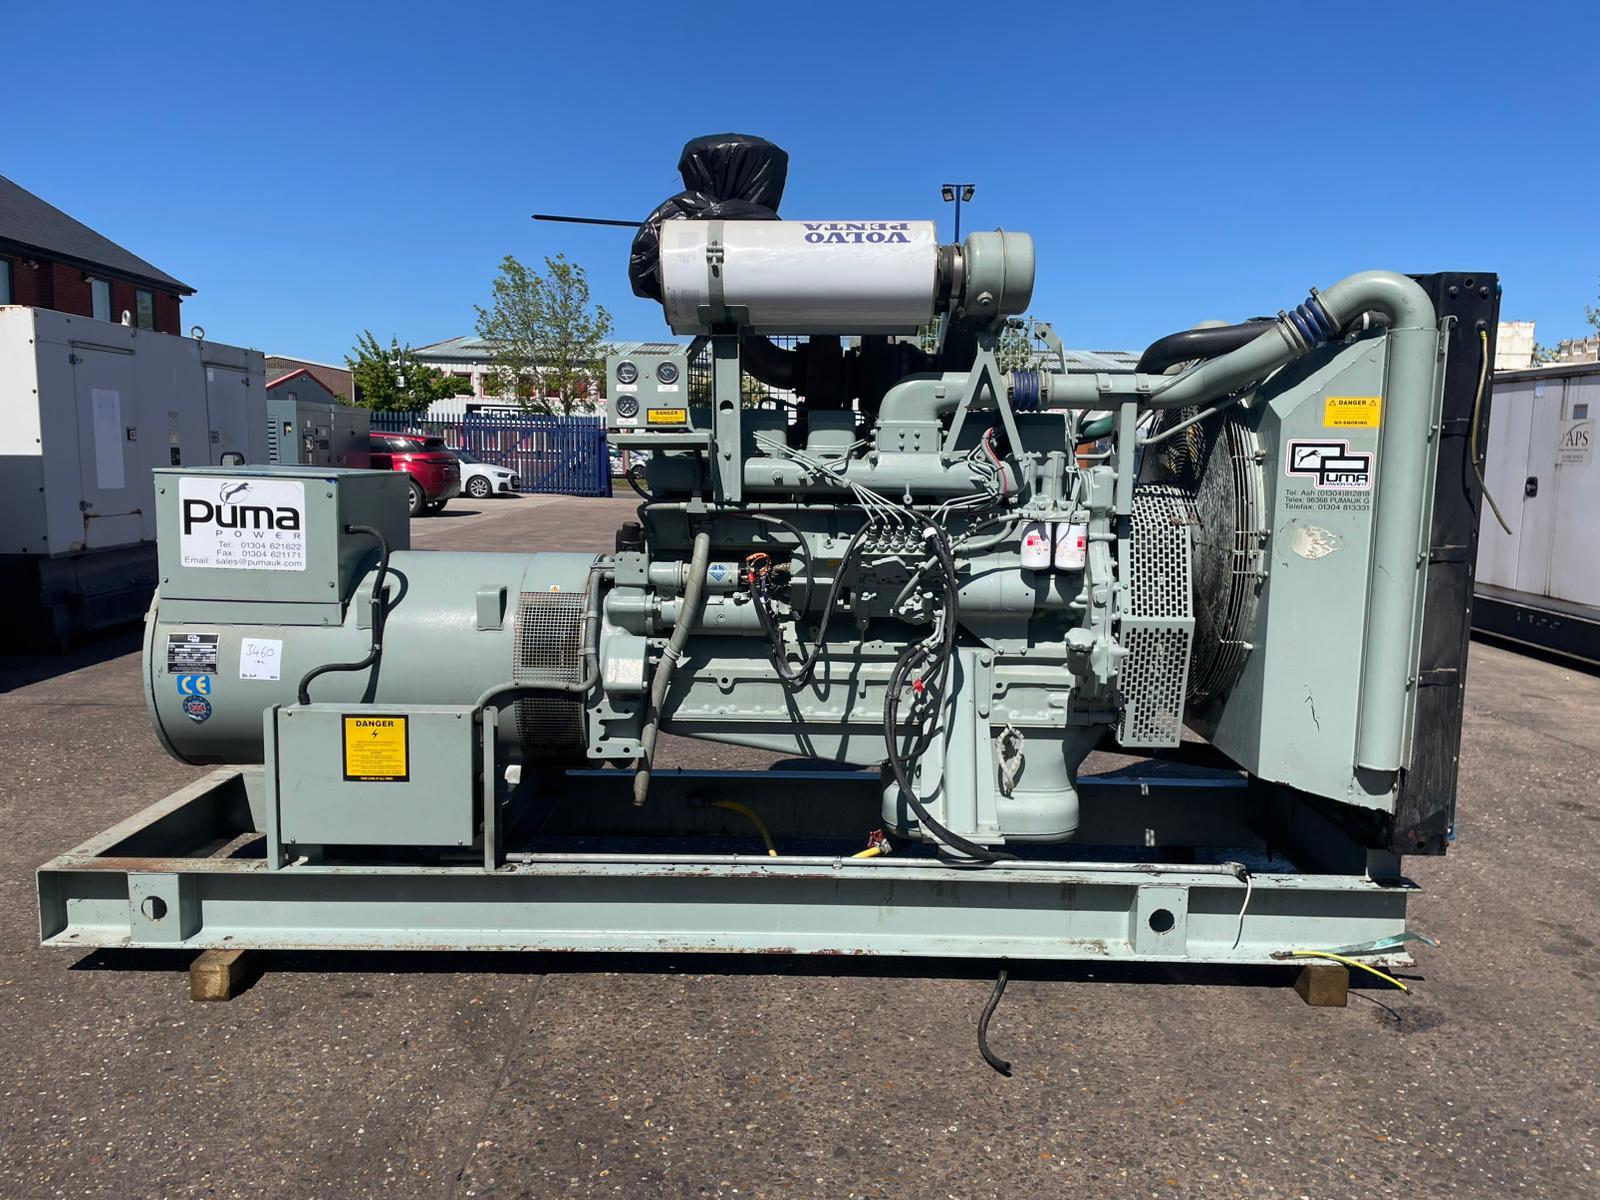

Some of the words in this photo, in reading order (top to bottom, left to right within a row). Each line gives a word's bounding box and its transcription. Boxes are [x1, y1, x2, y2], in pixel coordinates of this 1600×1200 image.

[803, 222, 911, 231] PENTA
[804, 232, 911, 244] VOLVO
[1565, 430, 1589, 447] APS
[216, 530, 301, 539] POWER
[270, 542, 302, 550] 621622
[184, 556, 210, 564] Email:
[216, 557, 302, 567] sales@pumauk.com
[246, 644, 275, 658] 3460
[181, 676, 207, 694] CE
[355, 720, 395, 728] DANGER
